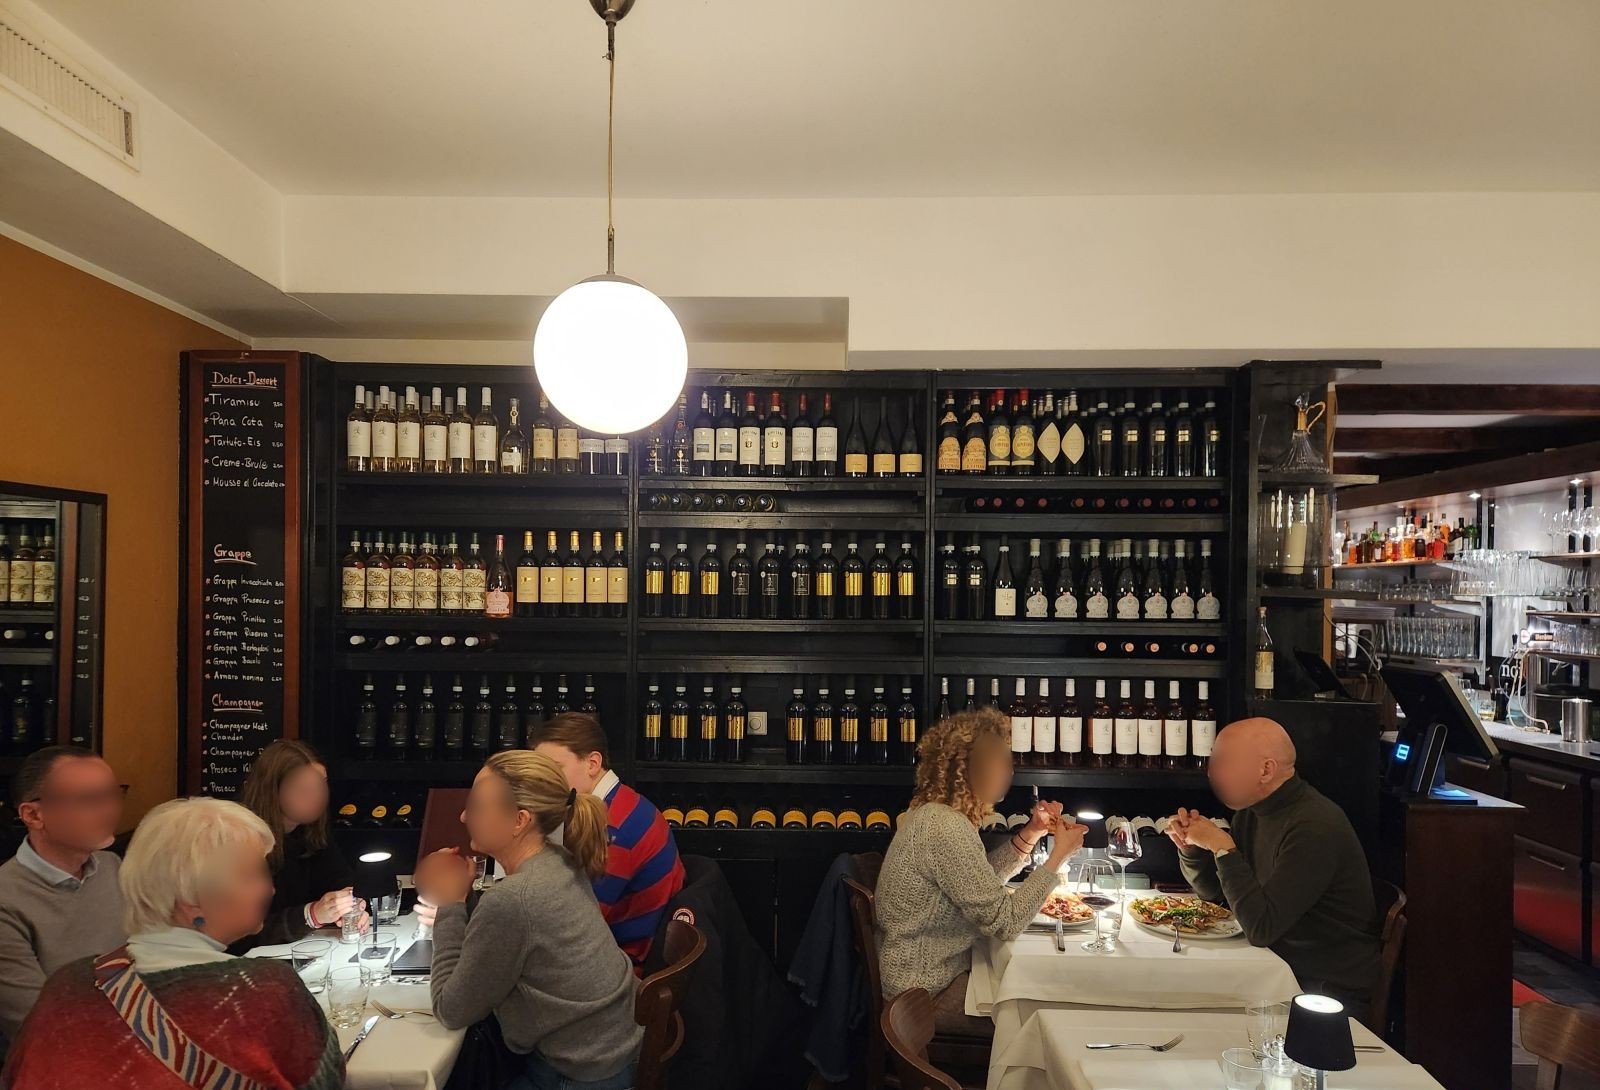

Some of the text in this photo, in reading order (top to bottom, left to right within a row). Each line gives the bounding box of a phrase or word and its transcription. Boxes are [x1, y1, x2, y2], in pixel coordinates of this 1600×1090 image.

[208, 393, 260, 407] Tiramisu
[209, 411, 237, 426] Pana
[213, 476, 241, 487] Mousse
[213, 574, 237, 589] Grappa
[212, 593, 238, 605] Grappa
[212, 612, 237, 624] Grappa
[213, 627, 238, 640] Grappa
[213, 643, 238, 655] Grappa
[213, 657, 238, 669] Grappa
[213, 671, 239, 681] Amaro
[211, 693, 264, 710] Champagner
[209, 719, 251, 732] Champagner
[210, 746, 255, 759] Champagner
